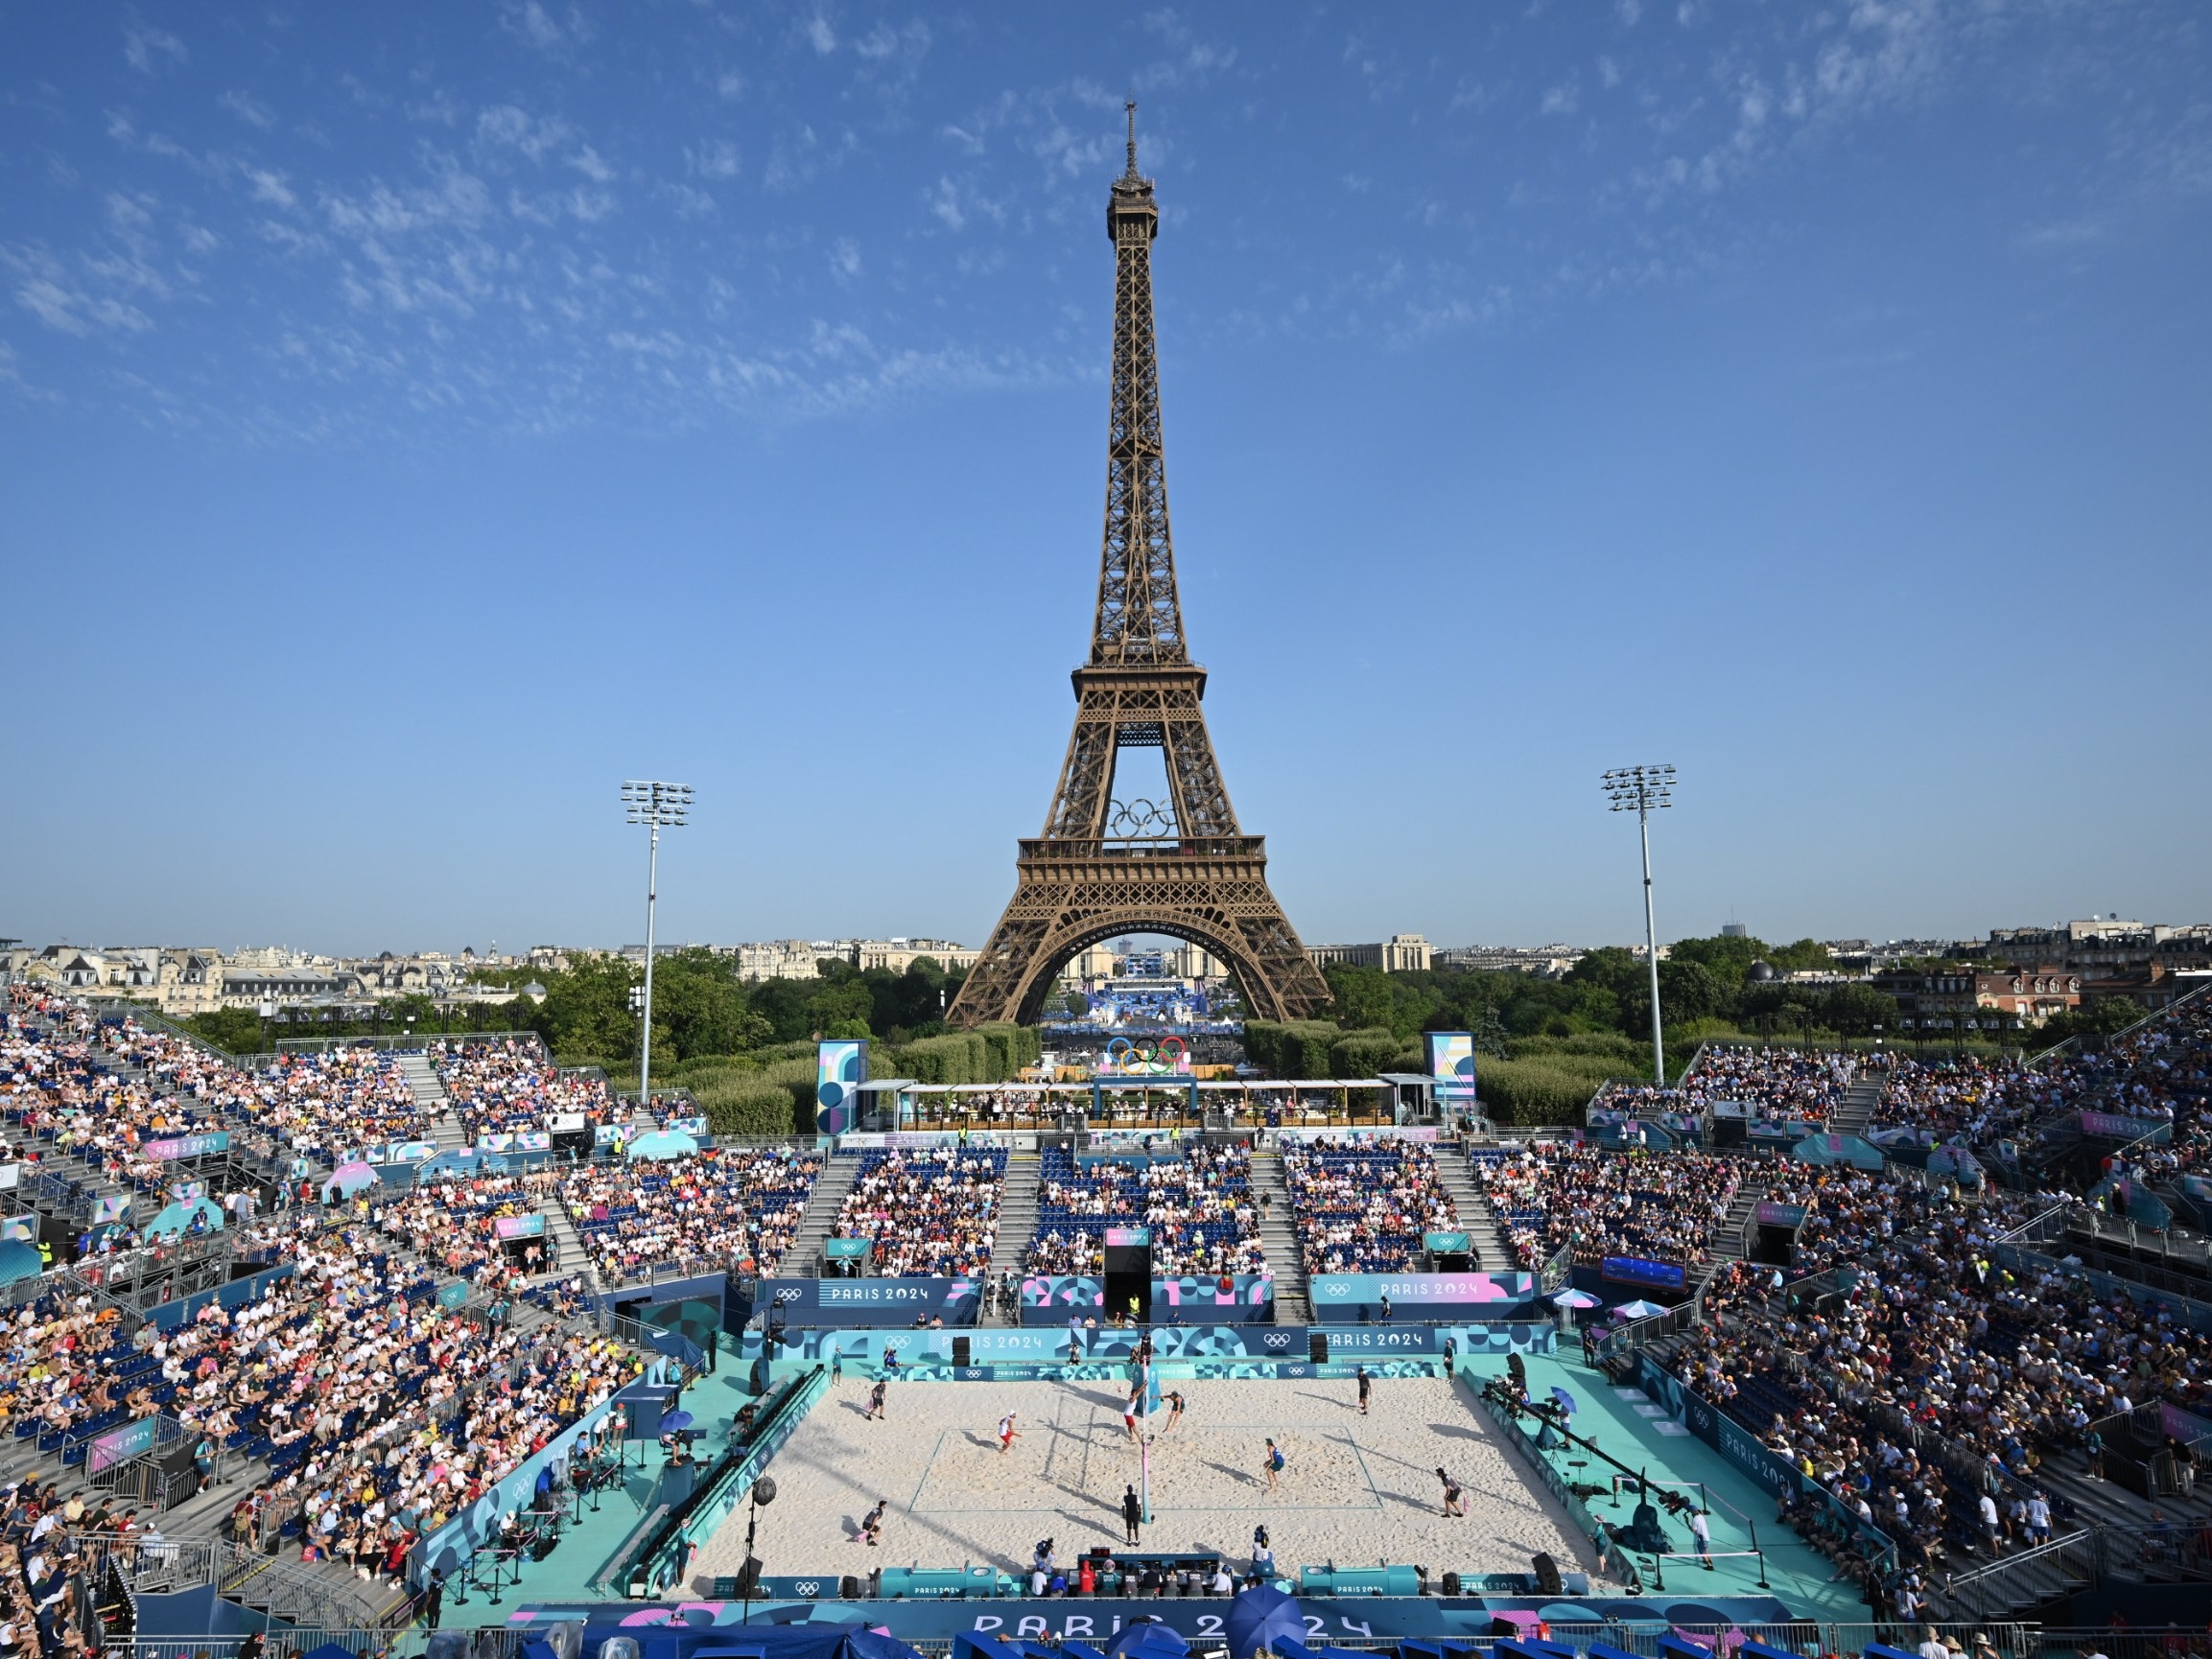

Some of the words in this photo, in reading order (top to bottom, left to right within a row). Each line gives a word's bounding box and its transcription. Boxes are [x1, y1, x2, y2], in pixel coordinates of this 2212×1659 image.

[156, 1142, 187, 1157] PARIS
[191, 1137, 217, 1151] 2024
[832, 1288, 880, 1300] PARIS
[885, 1288, 929, 1299] 2024
[1381, 1283, 1428, 1295] PARIS
[1434, 1282, 1477, 1295] 2024
[942, 1336, 991, 1348] PIS
[998, 1336, 1042, 1348] 2024
[1326, 1333, 1371, 1346] ARIS
[1377, 1333, 1423, 1346] 2024
[125, 1431, 149, 1447] 2024
[1727, 1434, 1758, 1470] PARIS
[1466, 1581, 1493, 1590] PARIS
[1494, 1581, 1519, 1590] 2024
[1196, 1615, 1373, 1637] 224
